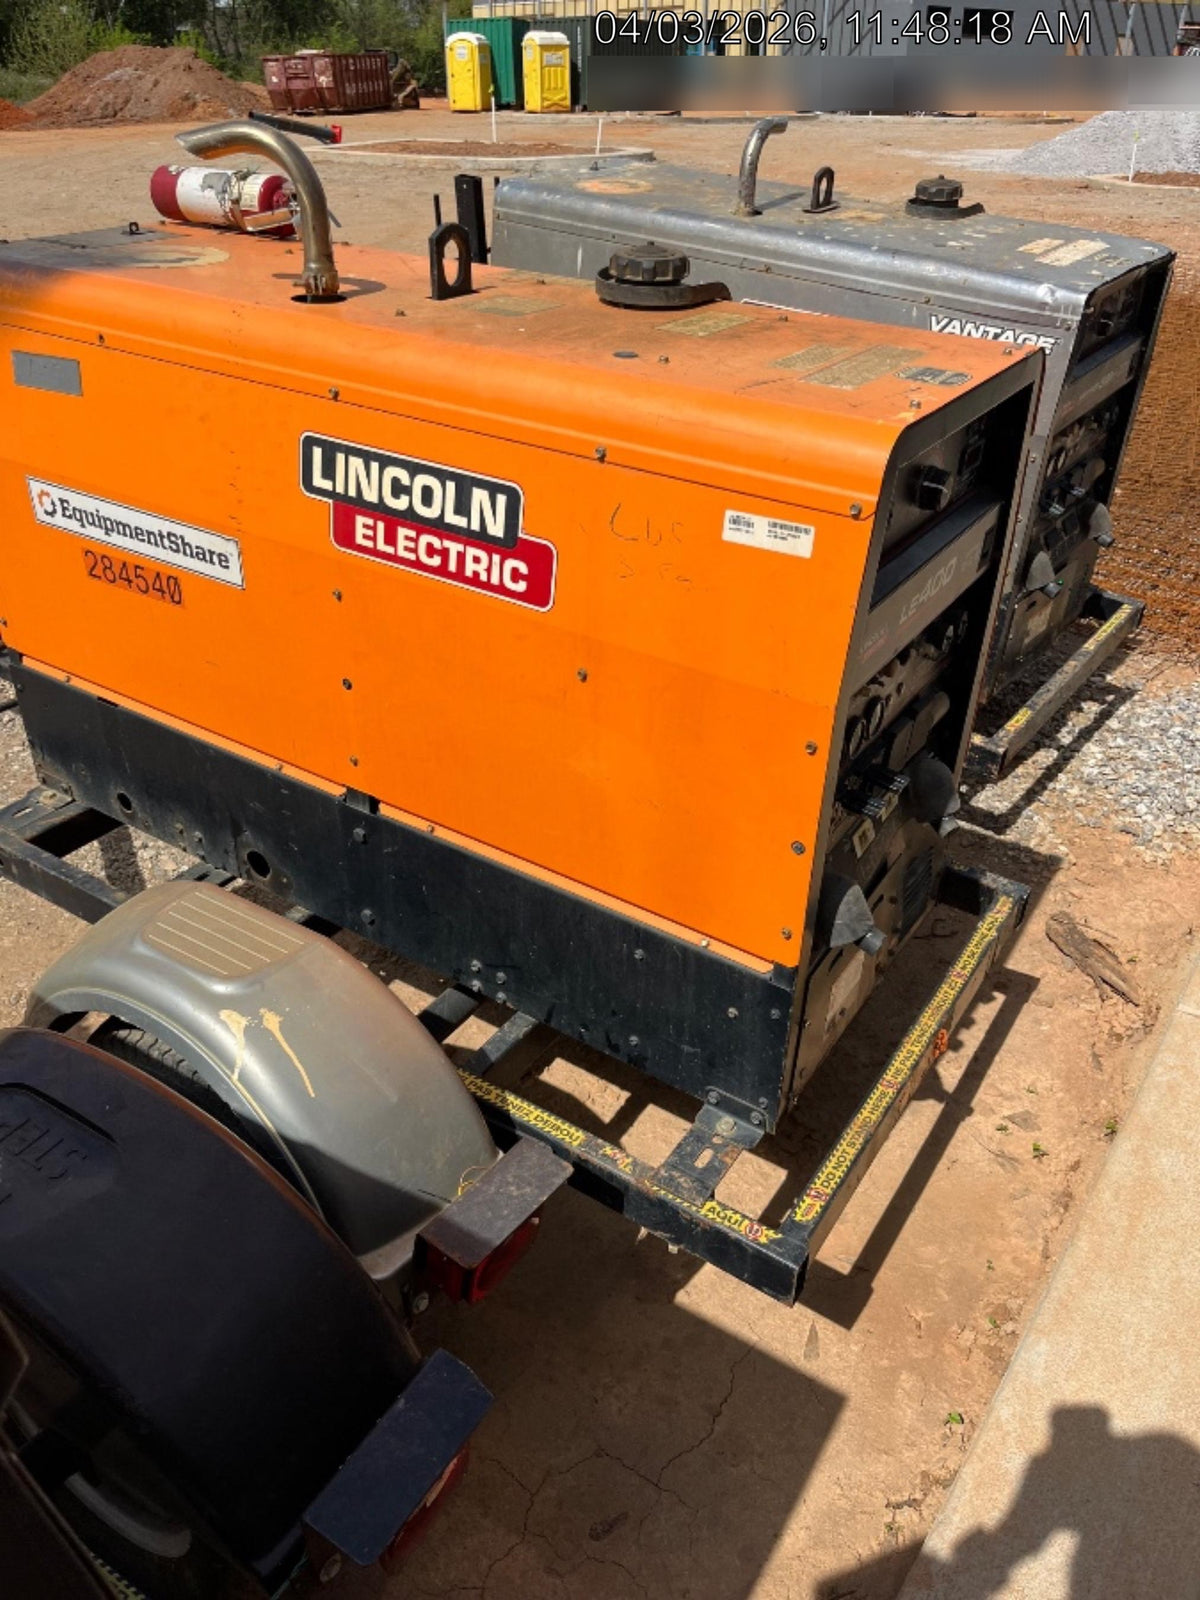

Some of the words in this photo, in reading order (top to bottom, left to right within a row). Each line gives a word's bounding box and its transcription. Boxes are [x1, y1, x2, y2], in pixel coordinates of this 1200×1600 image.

[312, 445, 507, 539] LINCOLN
[58, 497, 231, 569] EquipmentShare
[355, 515, 529, 593] ELECTRIC
[84, 550, 183, 605] 284540
[819, 1169, 836, 1190] DO
[830, 1148, 851, 1172] NOT
